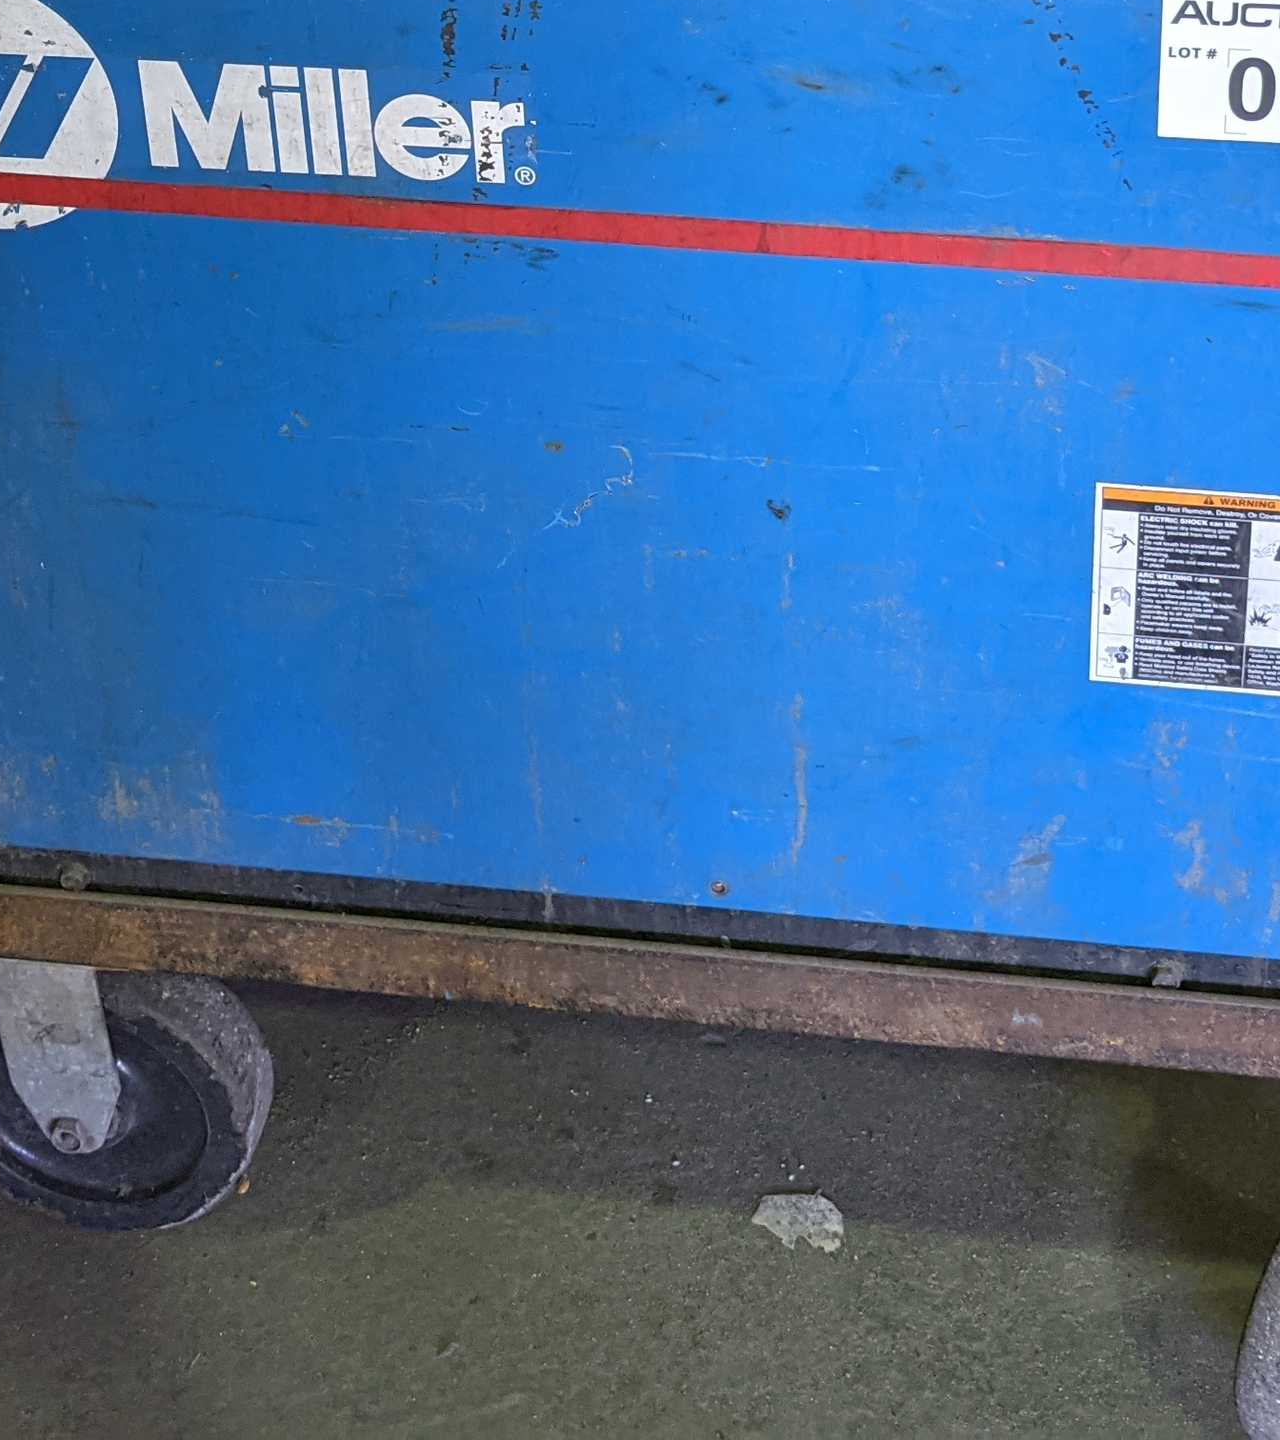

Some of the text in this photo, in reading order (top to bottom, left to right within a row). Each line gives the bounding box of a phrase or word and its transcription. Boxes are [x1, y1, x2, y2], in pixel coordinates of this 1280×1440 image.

[1168, 47, 1217, 60] LOT #
[137, 60, 525, 184] Miller
[1220, 498, 1276, 509] WARNING
[1156, 573, 1192, 581] WELDING
[1182, 641, 1208, 649] GASES
